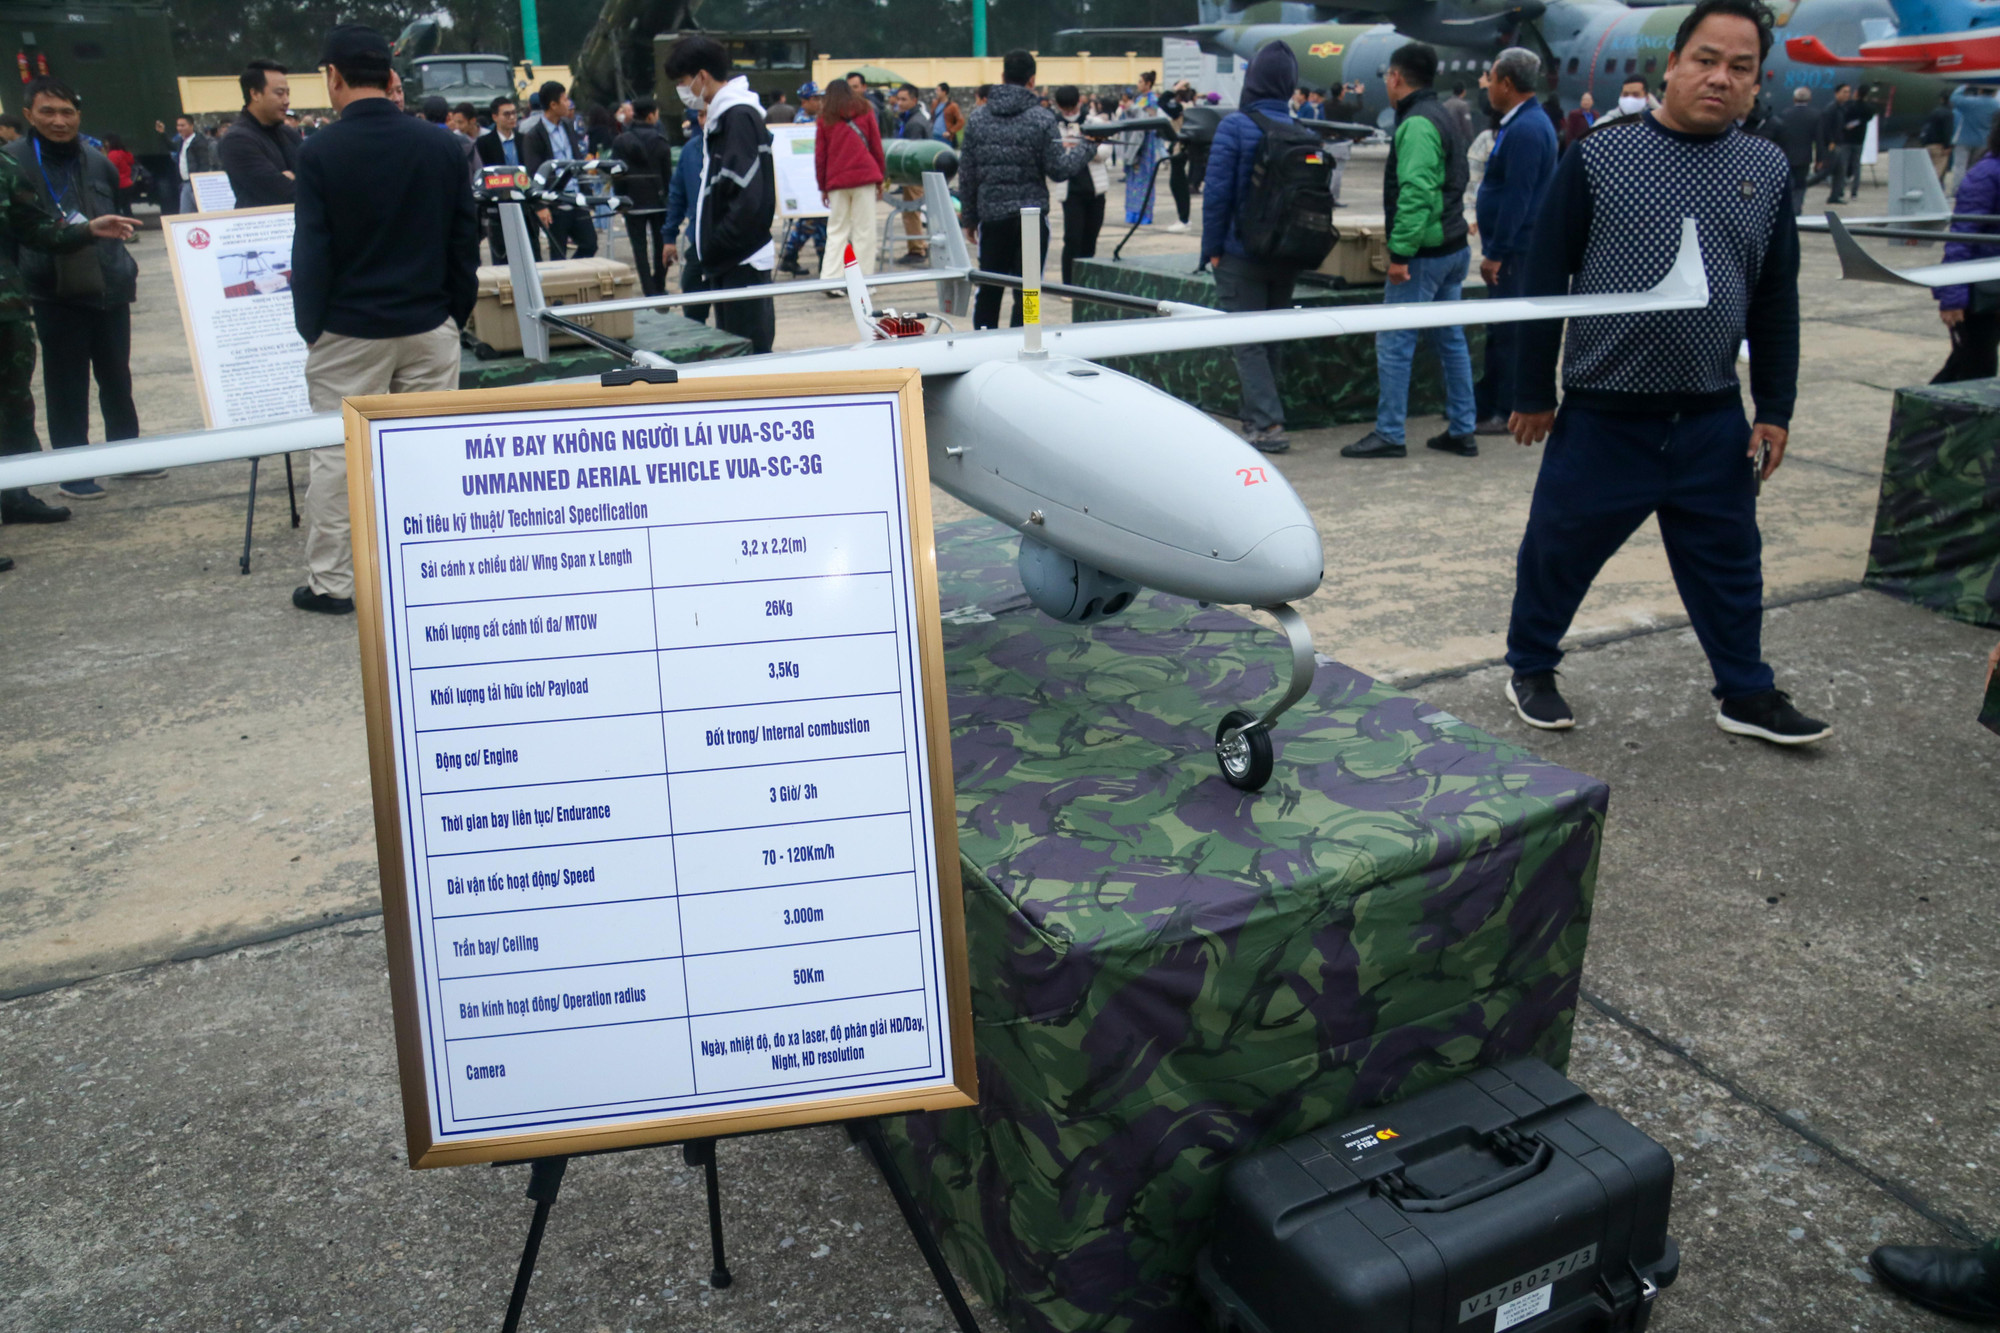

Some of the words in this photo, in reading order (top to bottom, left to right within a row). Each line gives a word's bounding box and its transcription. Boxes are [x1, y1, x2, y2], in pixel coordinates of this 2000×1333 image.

[465, 435, 506, 459] MÁY
[512, 434, 546, 456] BAY
[552, 430, 616, 454] KHÔNG
[621, 425, 678, 450] NGƯỜI
[684, 423, 712, 446] LÁI
[717, 419, 814, 444] VUA-SC-3G
[461, 469, 570, 496] UNMANNED
[576, 464, 641, 488] AERIAL
[645, 459, 720, 484] VEHICLE
[724, 453, 822, 479] VUA-SC-3G
[1236, 467, 1268, 487] 27
[403, 513, 423, 535] Chỉ
[425, 513, 449, 533] tiêu
[452, 512, 466, 533] kỹ
[469, 509, 504, 532] thuật/
[507, 505, 565, 527] Technical
[568, 501, 647, 525] Specification
[741, 539, 758, 556] 3,2
[761, 541, 768, 554] x
[771, 536, 806, 554] 2,2(m)
[420, 559, 437, 578] Sải
[440, 559, 465, 577] cánh
[468, 561, 475, 575] x
[477, 554, 506, 574] chiều
[509, 554, 529, 571] dài/
[531, 553, 557, 571] Wing
[560, 552, 586, 569] Span
[588, 553, 595, 566] x
[598, 548, 632, 566] Length
[765, 599, 792, 616] 26Kg
[424, 622, 448, 642] Khối
[451, 623, 480, 642] lượng
[482, 617, 499, 637] cất
[501, 618, 527, 636] cánh
[529, 614, 543, 634] tối
[545, 615, 562, 632] đa/
[564, 613, 597, 631] MTOW
[768, 660, 799, 679] 3,5Kg
[430, 685, 453, 705] Khối
[455, 687, 485, 706] lượng
[487, 682, 501, 701] tải
[503, 682, 523, 699] hữu
[525, 680, 545, 698] ích/
[547, 677, 588, 697] Payload
[705, 726, 724, 746] Đốt
[726, 725, 759, 744] trong/
[761, 722, 804, 741] Internal
[807, 717, 870, 737] combustion
[435, 751, 462, 772] Động
[464, 749, 480, 766] cơ/
[482, 747, 518, 765] Engine
[769, 786, 776, 803] 3
[779, 784, 801, 802] Giờ/
[803, 783, 817, 799] 3h
[440, 814, 463, 832] Thời
[465, 813, 488, 832] gian
[490, 811, 509, 829] bay
[511, 808, 532, 826] liên
[533, 806, 554, 827] tục/
[556, 804, 610, 822] Endurance
[761, 848, 776, 865] 70
[786, 843, 834, 863] 120Km/h
[446, 876, 464, 895] Dải
[466, 876, 485, 896] vận
[487, 872, 504, 891] tốc
[506, 872, 529, 891] hoạt
[531, 869, 560, 890] động/
[562, 866, 595, 886] Speed
[783, 906, 823, 925] 3.000m
[452, 937, 475, 957] Trần
[477, 936, 499, 955] bay/
[502, 934, 538, 952] Ceiling
[792, 967, 824, 985] 50Km
[459, 1001, 479, 1019] Bán
[481, 999, 504, 1017] kính
[506, 997, 529, 1016] hoạt
[562, 990, 611, 1010] Operation
[613, 986, 646, 1004] radius
[700, 1038, 727, 1057] Ngày,
[729, 1035, 754, 1054] nhiệt
[756, 1033, 771, 1052] độ,
[773, 1032, 785, 1047] đo
[787, 1032, 799, 1046] xa
[801, 1028, 828, 1044] laser,
[829, 1024, 842, 1043] độ
[843, 1021, 867, 1040] phân
[869, 1017, 887, 1038] giải
[889, 1016, 924, 1033] HD/Day,
[771, 1052, 800, 1070] Night,
[801, 1050, 815, 1066] HD
[817, 1045, 864, 1064] resolution
[465, 1063, 505, 1080] Camera
[1357, 1138, 1379, 1150] PELI
[1468, 1250, 1590, 1313] V17B027/3
